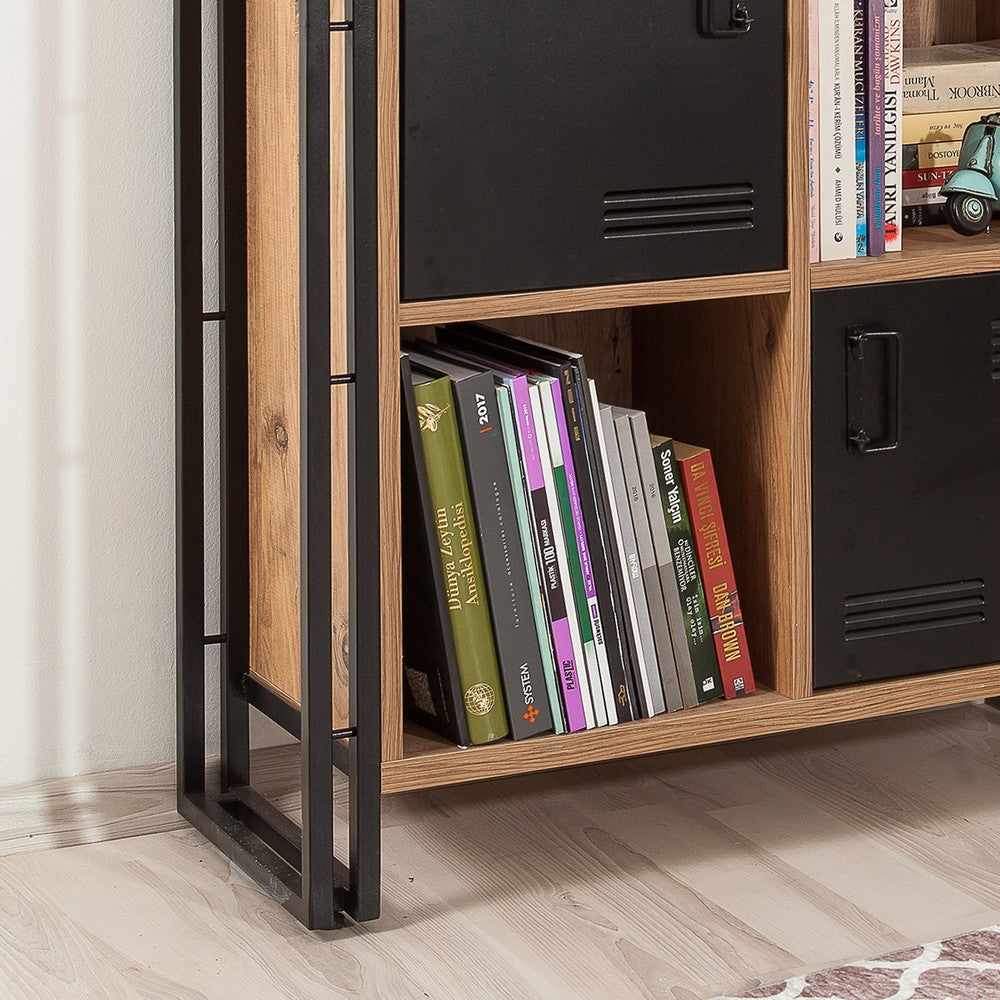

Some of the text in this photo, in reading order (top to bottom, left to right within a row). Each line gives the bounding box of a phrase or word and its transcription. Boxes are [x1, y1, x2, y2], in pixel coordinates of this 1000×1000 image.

[872, 16, 881, 135] tarihte ve bugün şamanizm
[890, 20, 900, 84] DAWKINS
[854, 60, 865, 140] MUCİZELERİ
[903, 88, 939, 100] Thoma
[904, 77, 935, 87] Mann
[885, 90, 898, 179] YANILGISI
[928, 150, 959, 159] DOSTOYE
[476, 394, 488, 425] 2017
[660, 449, 682, 524] Soner Yalçın
[540, 520, 552, 546] MARKASI
[690, 461, 726, 570] DA VINCI ŞİFRESİ
[435, 507, 462, 610] Dünya Zeytin
[451, 502, 479, 605] Ansiklopedisi
[493, 482, 520, 628] furniture accessories catalogue
[544, 546, 556, 565] 100
[712, 582, 731, 612] DAN
[718, 612, 741, 662] BROWN
[520, 662, 534, 705] SYSTEM
[563, 660, 574, 690] PLASTIC
